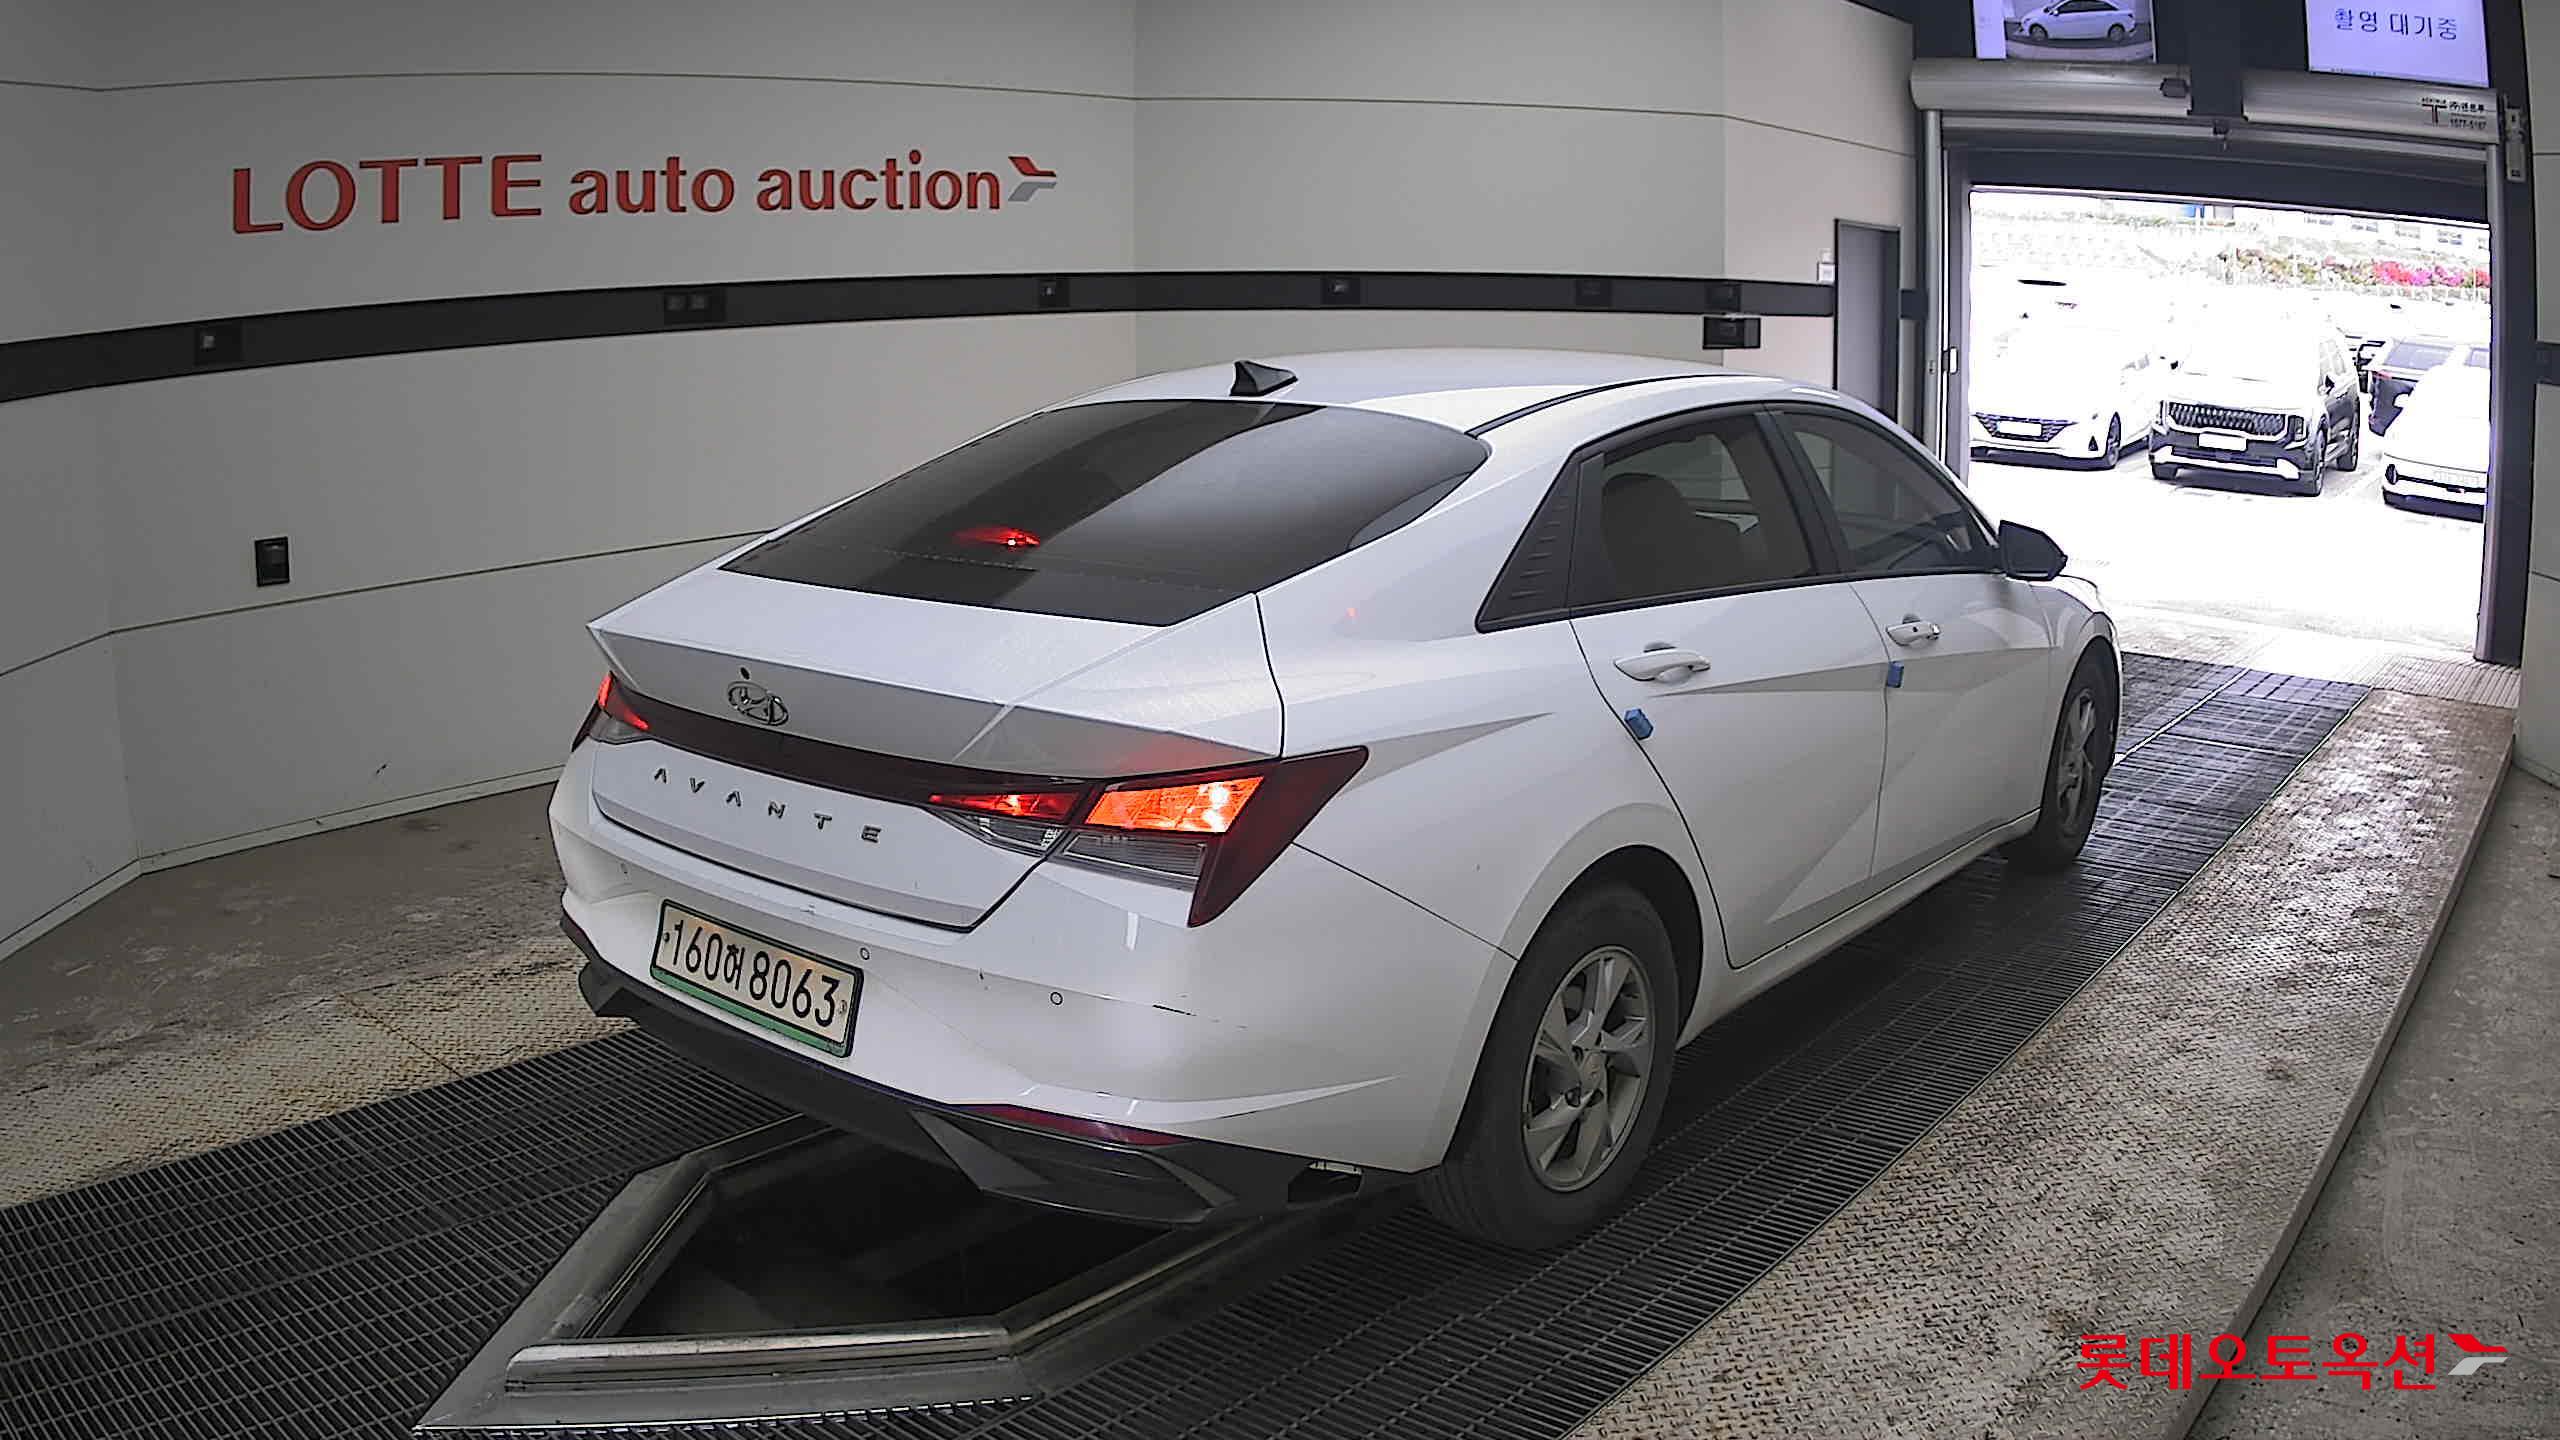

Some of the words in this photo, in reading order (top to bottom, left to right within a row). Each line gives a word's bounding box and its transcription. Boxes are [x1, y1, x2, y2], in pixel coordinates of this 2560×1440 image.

[2390, 13, 2457, 40] 대기중
[234, 154, 541, 233] LOTTE
[569, 156, 734, 214] auto
[757, 150, 999, 210] auction
[654, 768, 881, 844] AVANTE
